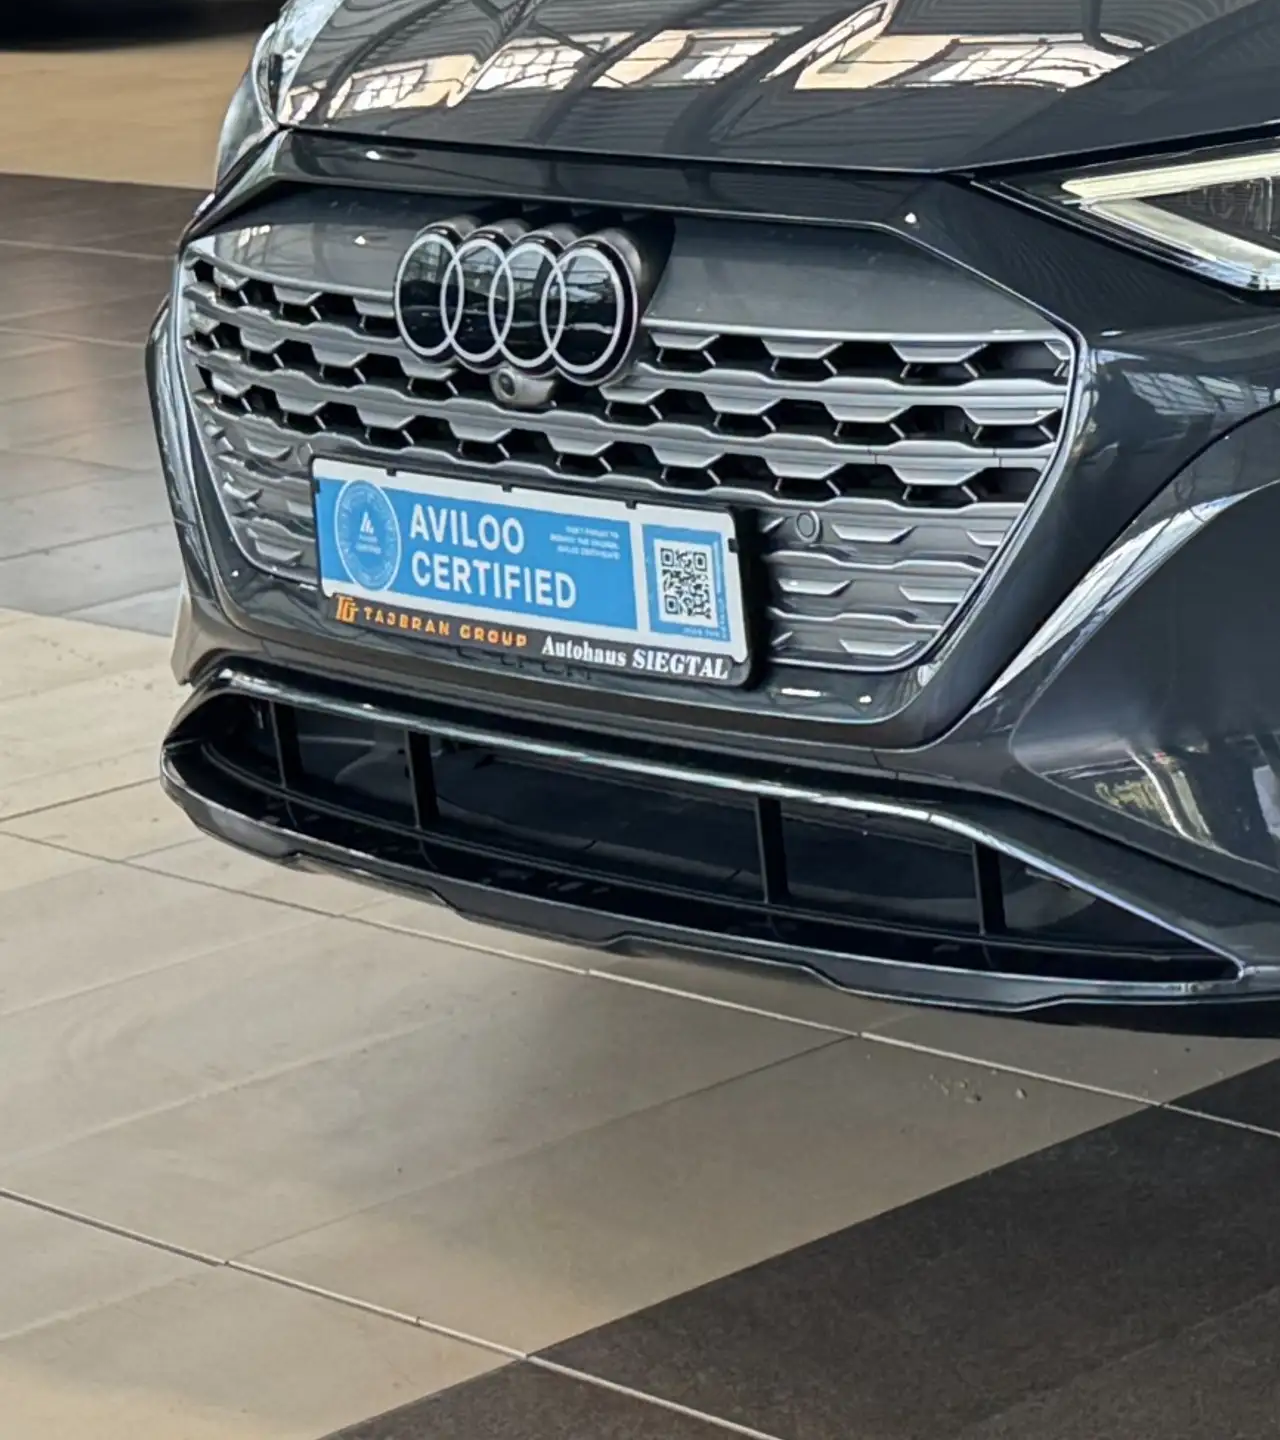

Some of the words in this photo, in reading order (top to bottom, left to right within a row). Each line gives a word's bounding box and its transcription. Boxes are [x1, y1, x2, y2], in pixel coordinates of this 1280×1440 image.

[409, 503, 525, 555] AVILOO
[411, 550, 577, 609] CERTIFIED
[459, 623, 528, 648] GROUP
[541, 635, 627, 668] Autohaus
[632, 647, 729, 681] SIEGTAL
